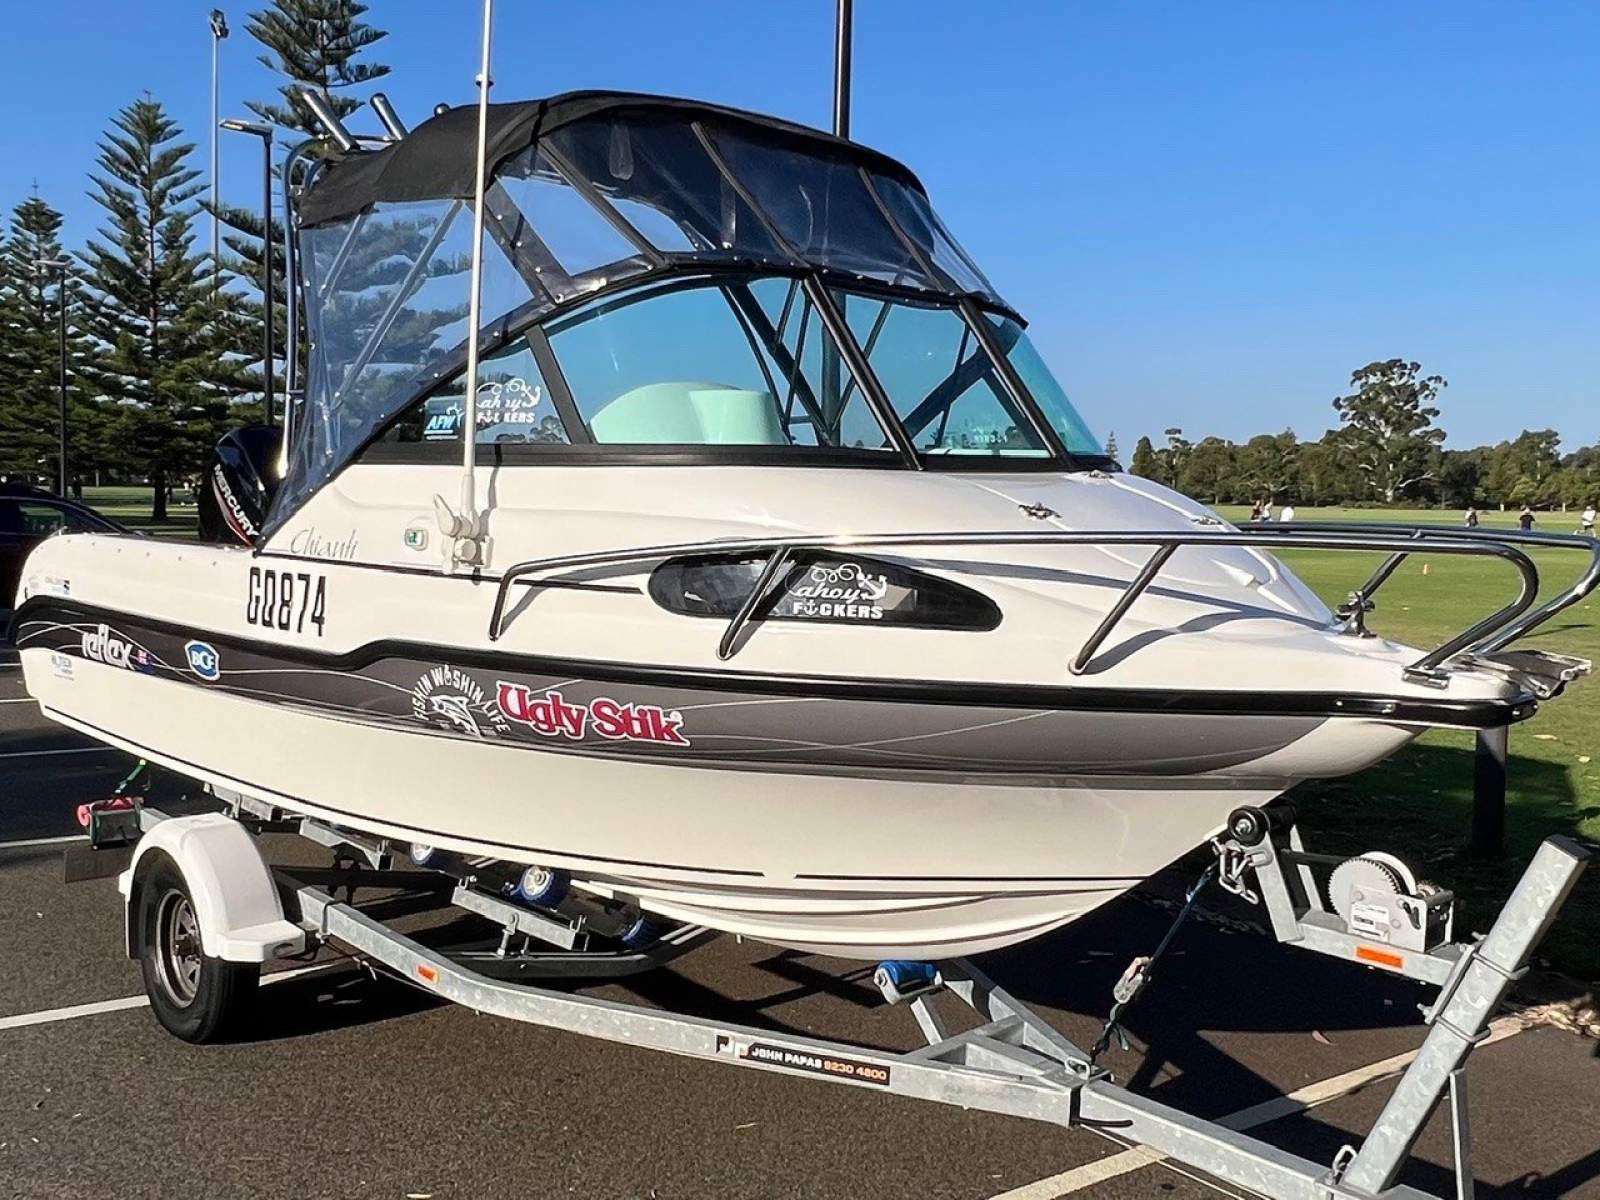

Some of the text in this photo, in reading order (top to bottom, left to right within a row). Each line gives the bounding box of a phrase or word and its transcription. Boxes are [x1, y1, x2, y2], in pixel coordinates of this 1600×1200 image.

[213, 463, 260, 536] MERCURY
[789, 582, 862, 605] ahoy
[190, 649, 215, 670] BCF
[412, 674, 433, 721] FISHIN
[482, 701, 511, 732] LIFE
[497, 680, 690, 746] Ugly Stik
[751, 1047, 783, 1062] JOHN
[784, 1053, 823, 1069] PAPAS
